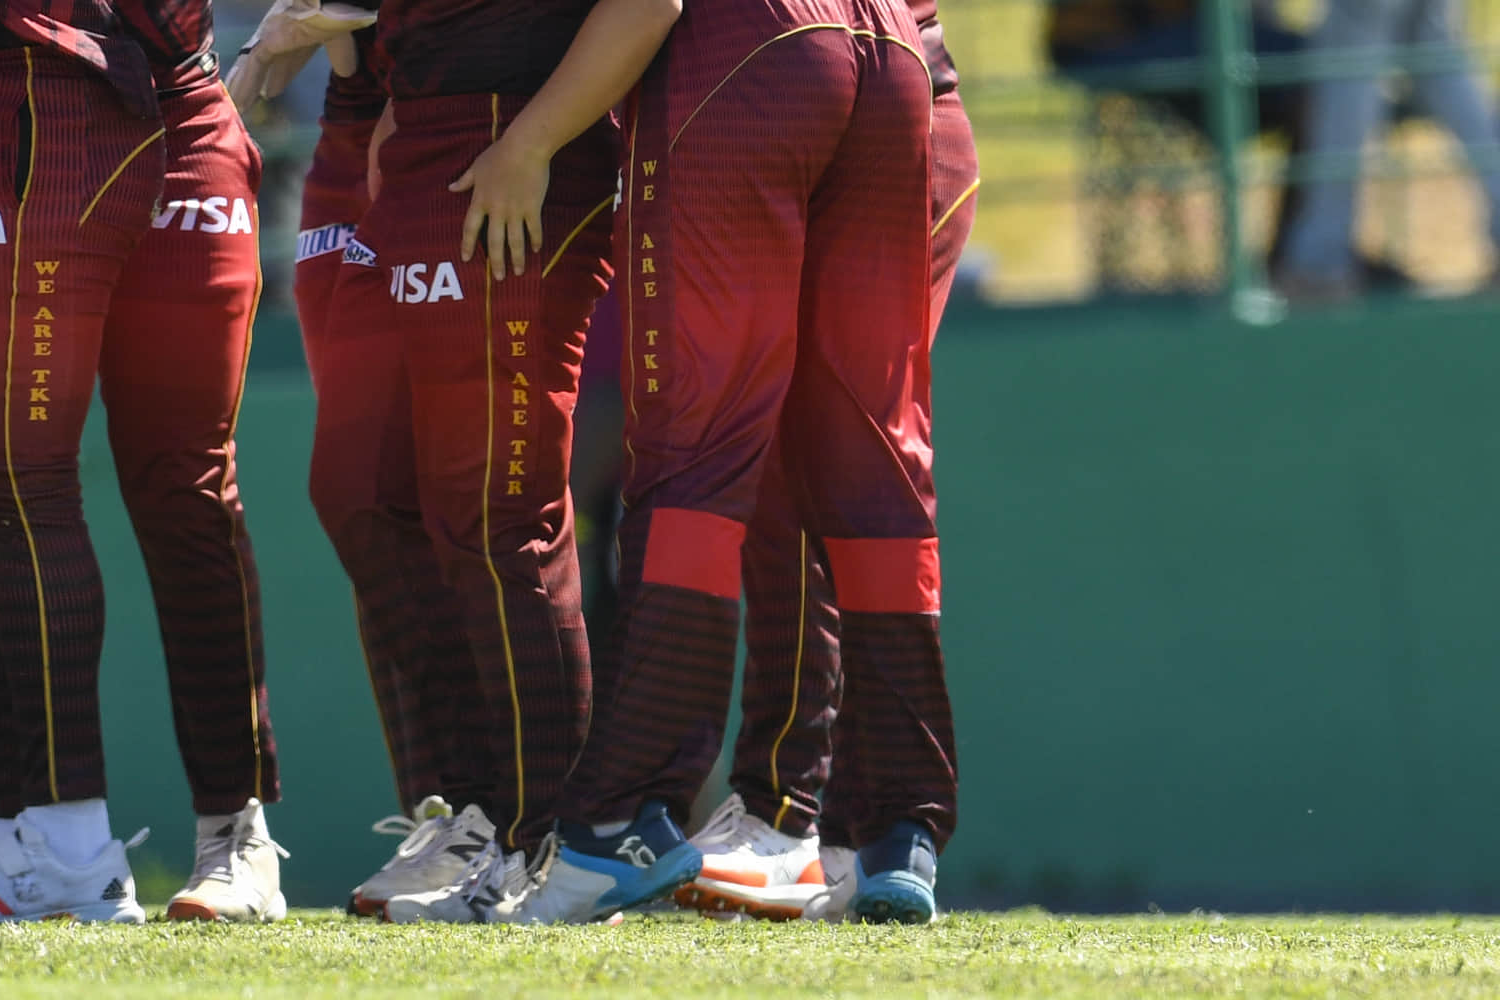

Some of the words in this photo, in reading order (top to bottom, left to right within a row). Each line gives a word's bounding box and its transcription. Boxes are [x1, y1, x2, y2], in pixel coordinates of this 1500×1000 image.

[641, 160, 658, 201] WE
[33, 260, 61, 294] WE
[641, 232, 658, 298] ARE
[33, 306, 55, 356] ARE
[506, 320, 530, 357] WE
[644, 330, 659, 393] TKR
[28, 369, 51, 421] TKR
[512, 371, 529, 425] ARE
[507, 439, 527, 495] TKR
